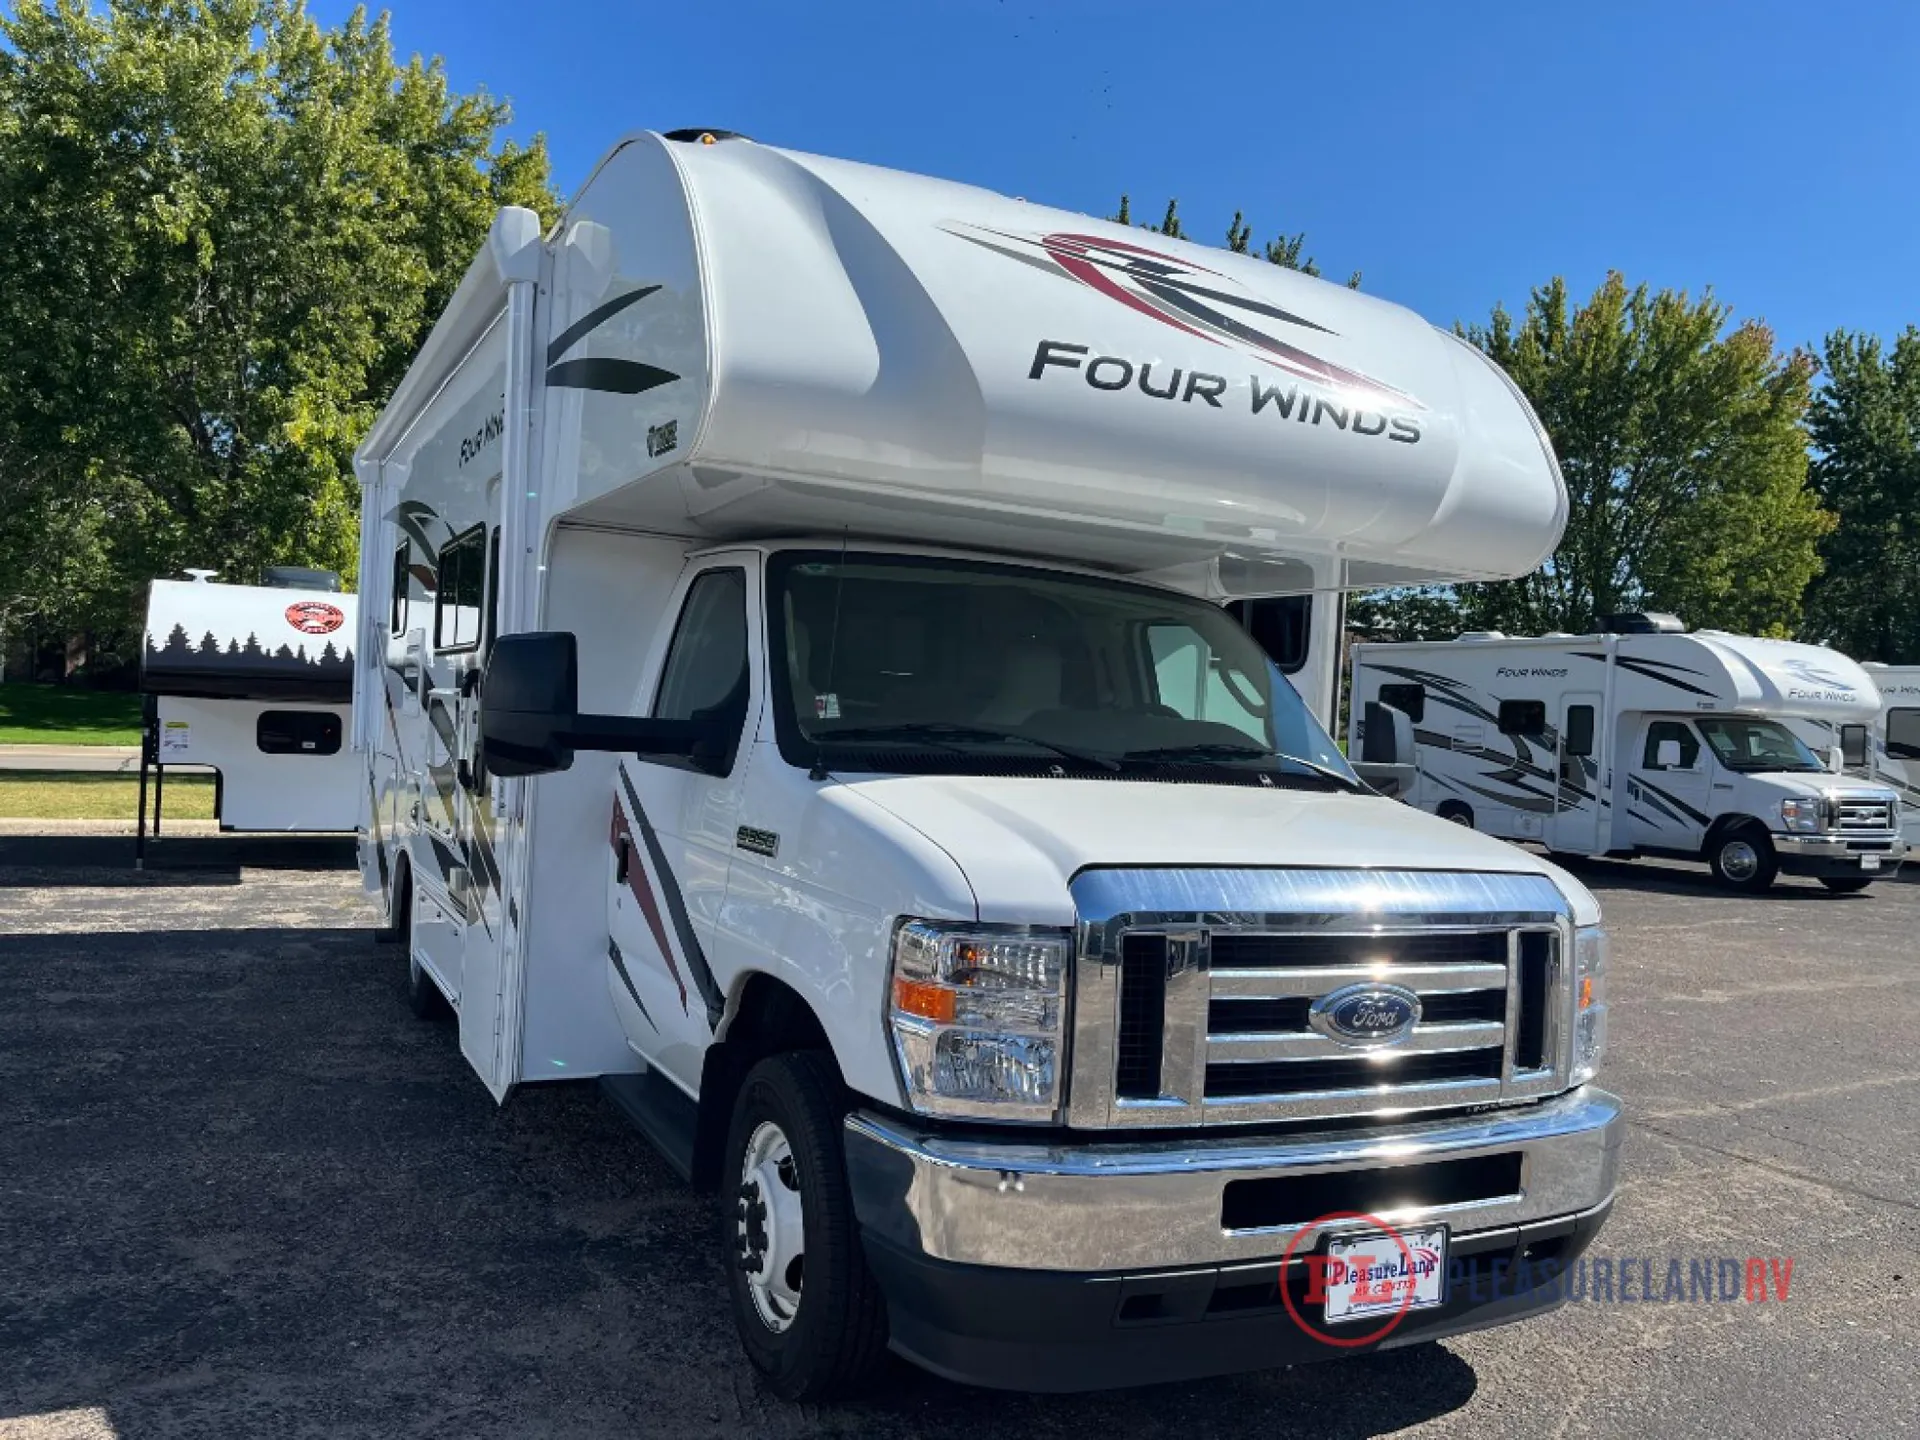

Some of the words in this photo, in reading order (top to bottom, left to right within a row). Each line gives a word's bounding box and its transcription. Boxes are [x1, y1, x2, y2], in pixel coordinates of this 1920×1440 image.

[1028, 339, 1227, 408] FOUR
[1249, 373, 1421, 444] WINDS
[1496, 666, 1529, 678] FOUR
[1531, 667, 1568, 678] WINDS
[1351, 1001, 1399, 1028] Ford
